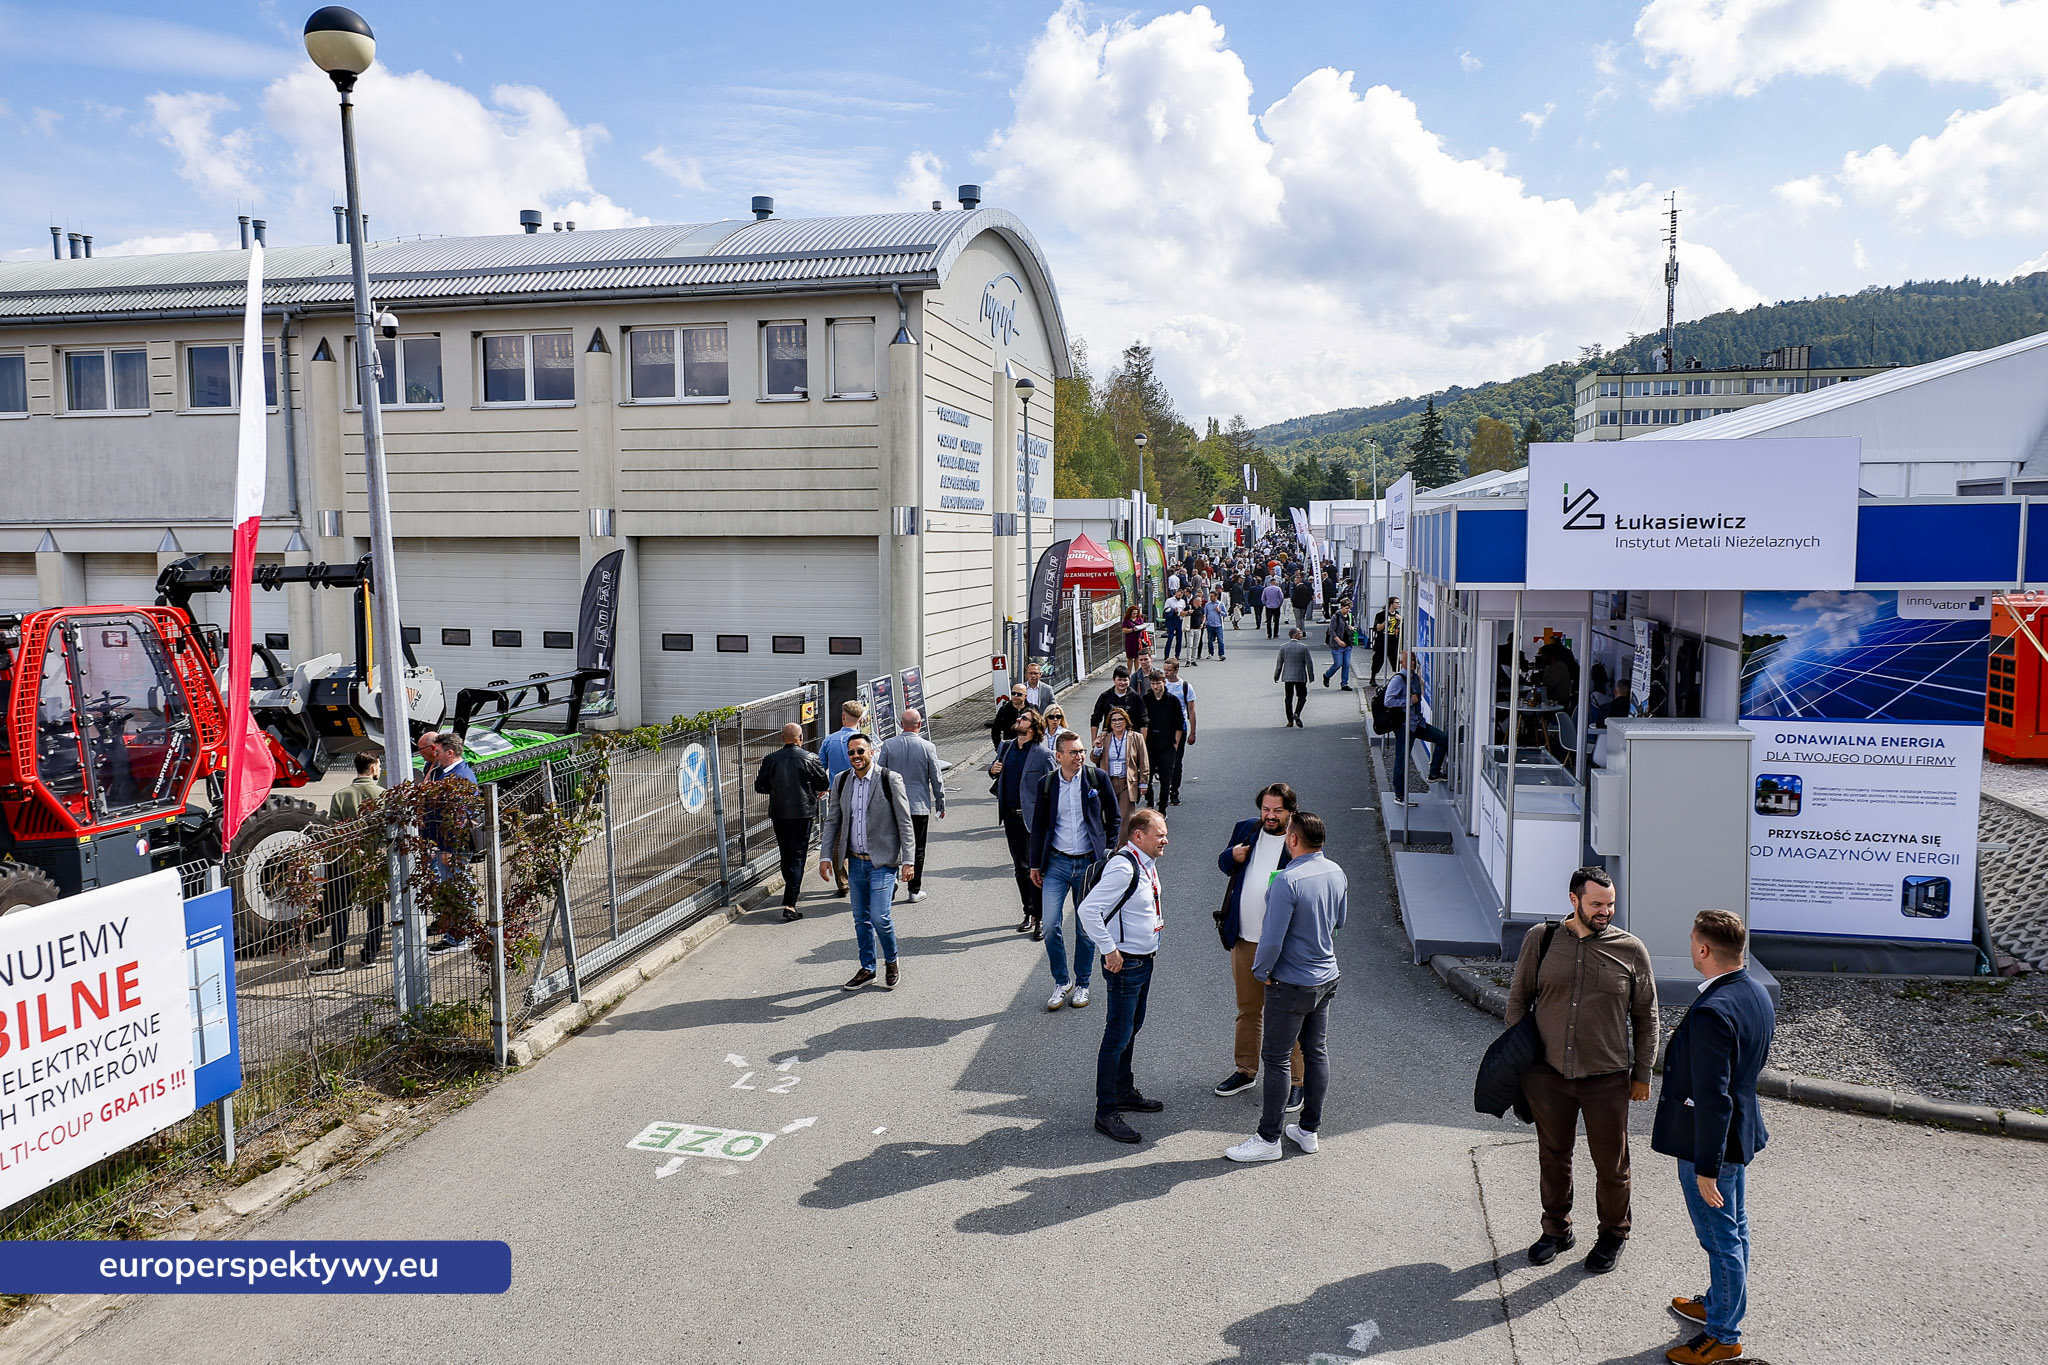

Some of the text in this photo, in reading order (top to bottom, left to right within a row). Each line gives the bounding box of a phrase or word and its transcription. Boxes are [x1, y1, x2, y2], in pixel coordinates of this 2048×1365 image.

[1615, 513, 1746, 530] Łukasiewicz
[1615, 535, 1821, 550] Instytut Metali Nieżelaznych
[995, 657, 1004, 670] 4
[1775, 734, 1946, 749] ODNAWIALNA ENERGIA
[1766, 751, 1791, 761] DLA
[1794, 752, 1860, 764] TWOJEGO
[1864, 754, 1905, 765] DOMU
[1915, 756, 1956, 766] FIRMY
[1768, 829, 1942, 848] PRZYSZŁOŚĆ ZACZYNA SIĘ
[1750, 845, 1960, 866] OD MAGAZYNÓW ENERGII
[3, 1012, 161, 1096] ELEKTRYCZNE
[25, 1043, 159, 1117] TRYMERÓW
[100, 1079, 166, 1122] GRATIS
[638, 1126, 764, 1157] OZE
